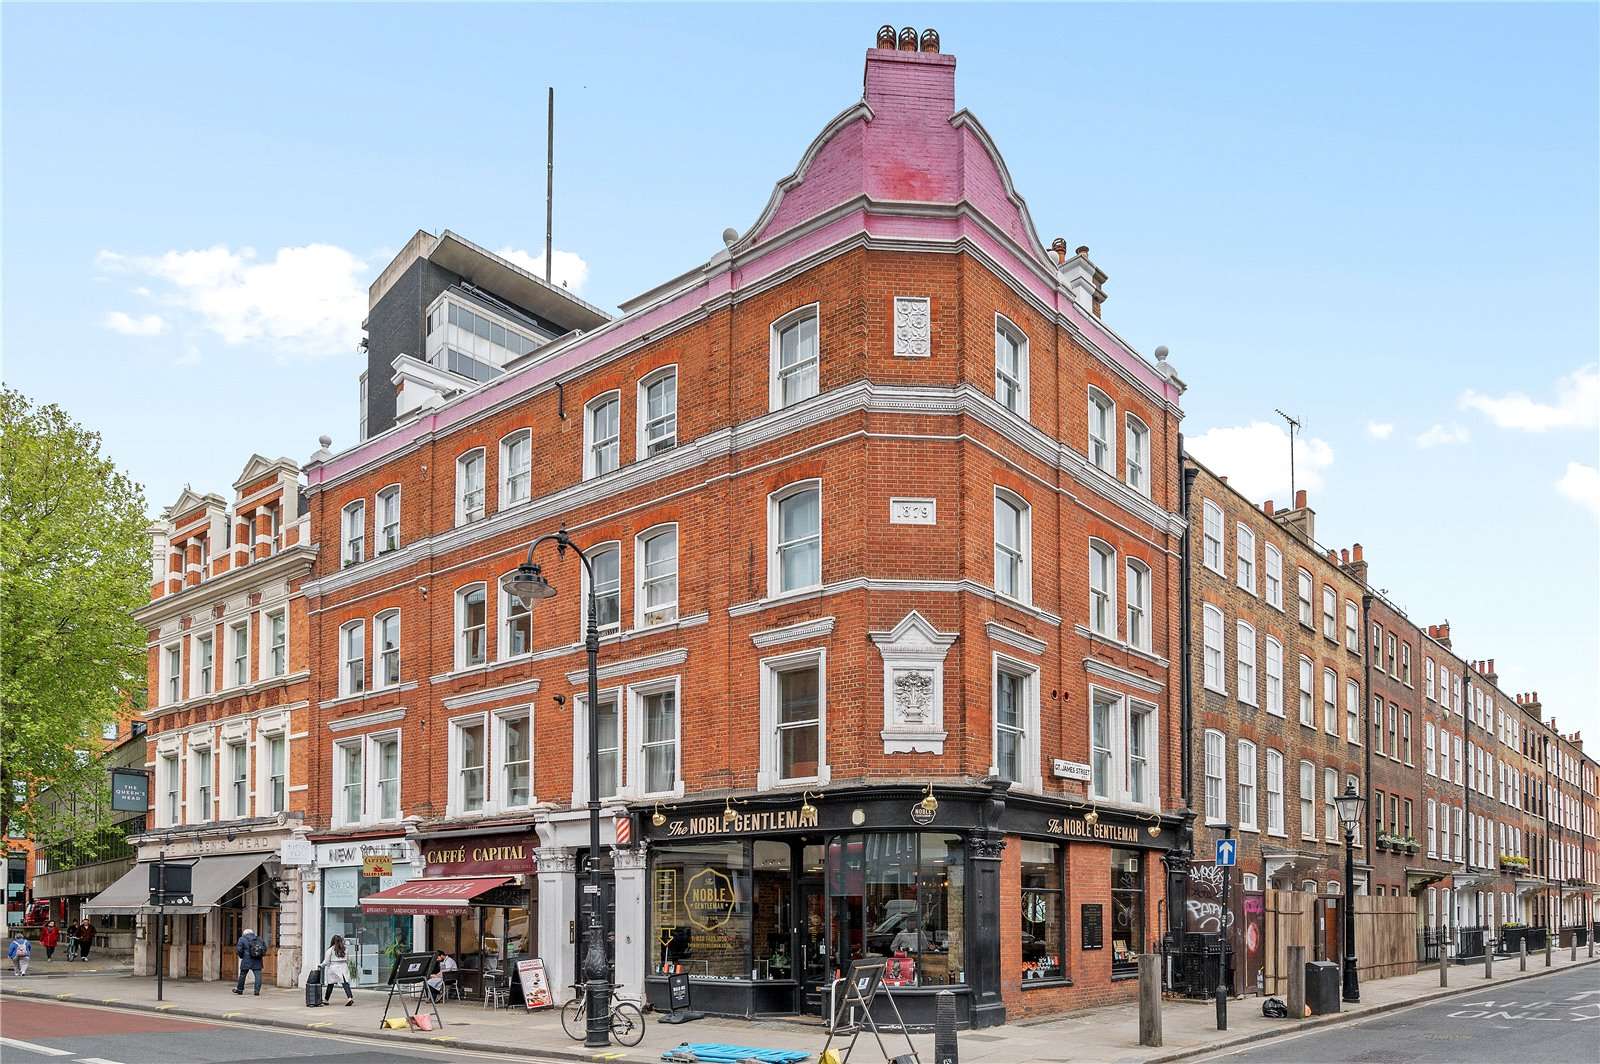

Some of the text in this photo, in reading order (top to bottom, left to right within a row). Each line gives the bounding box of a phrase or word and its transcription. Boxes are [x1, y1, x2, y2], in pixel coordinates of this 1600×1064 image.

[1062, 765, 1075, 773] JAMES
[668, 810, 818, 836] The NOBLE GENTLEMAN
[1047, 819, 1138, 842] The NOBLE GENTLEMAN
[238, 837, 269, 849] HEAD
[328, 847, 357, 863] NEW
[428, 845, 526, 863] CAFFÉ CAPITAL
[692, 888, 726, 902] NOBLE
[694, 902, 725, 910] GENTLEMAN
